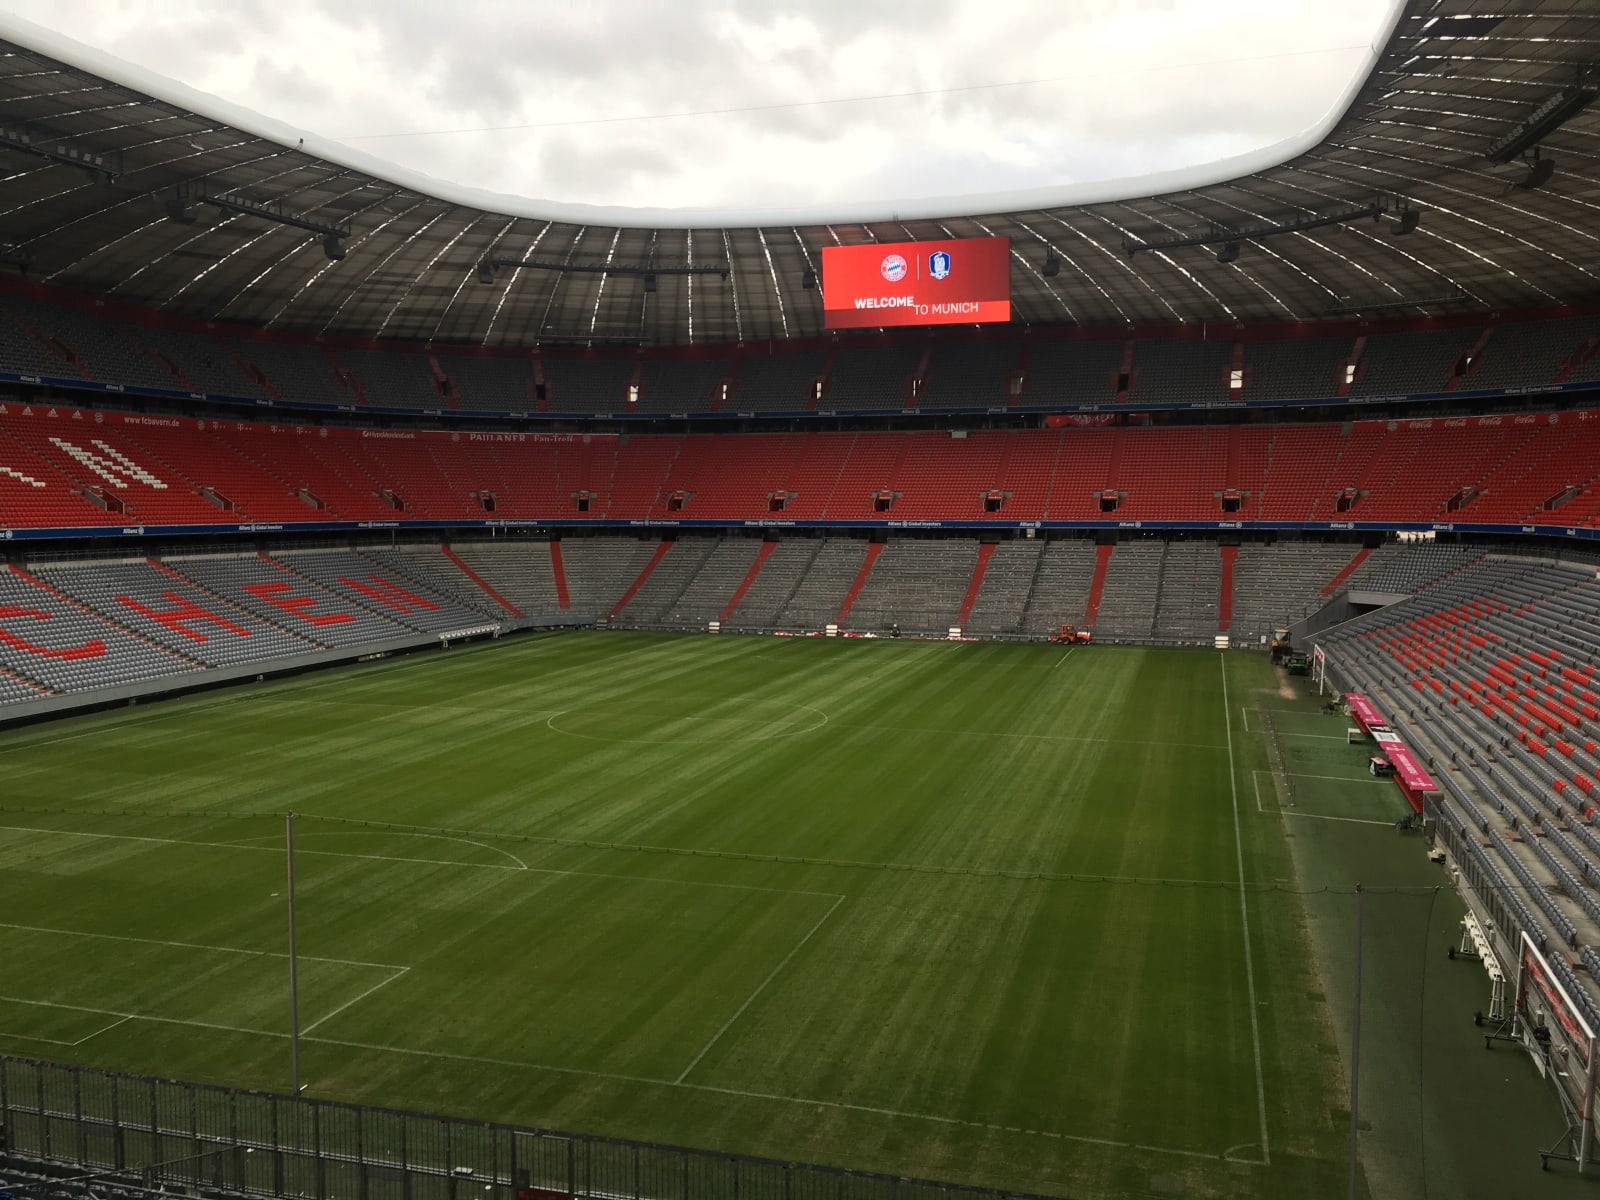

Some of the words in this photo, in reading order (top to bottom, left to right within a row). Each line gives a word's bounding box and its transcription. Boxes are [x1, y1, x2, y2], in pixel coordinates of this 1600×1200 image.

[854, 296, 914, 309] WELCOME
[914, 304, 928, 316] TO
[932, 302, 978, 315] MUNICH
